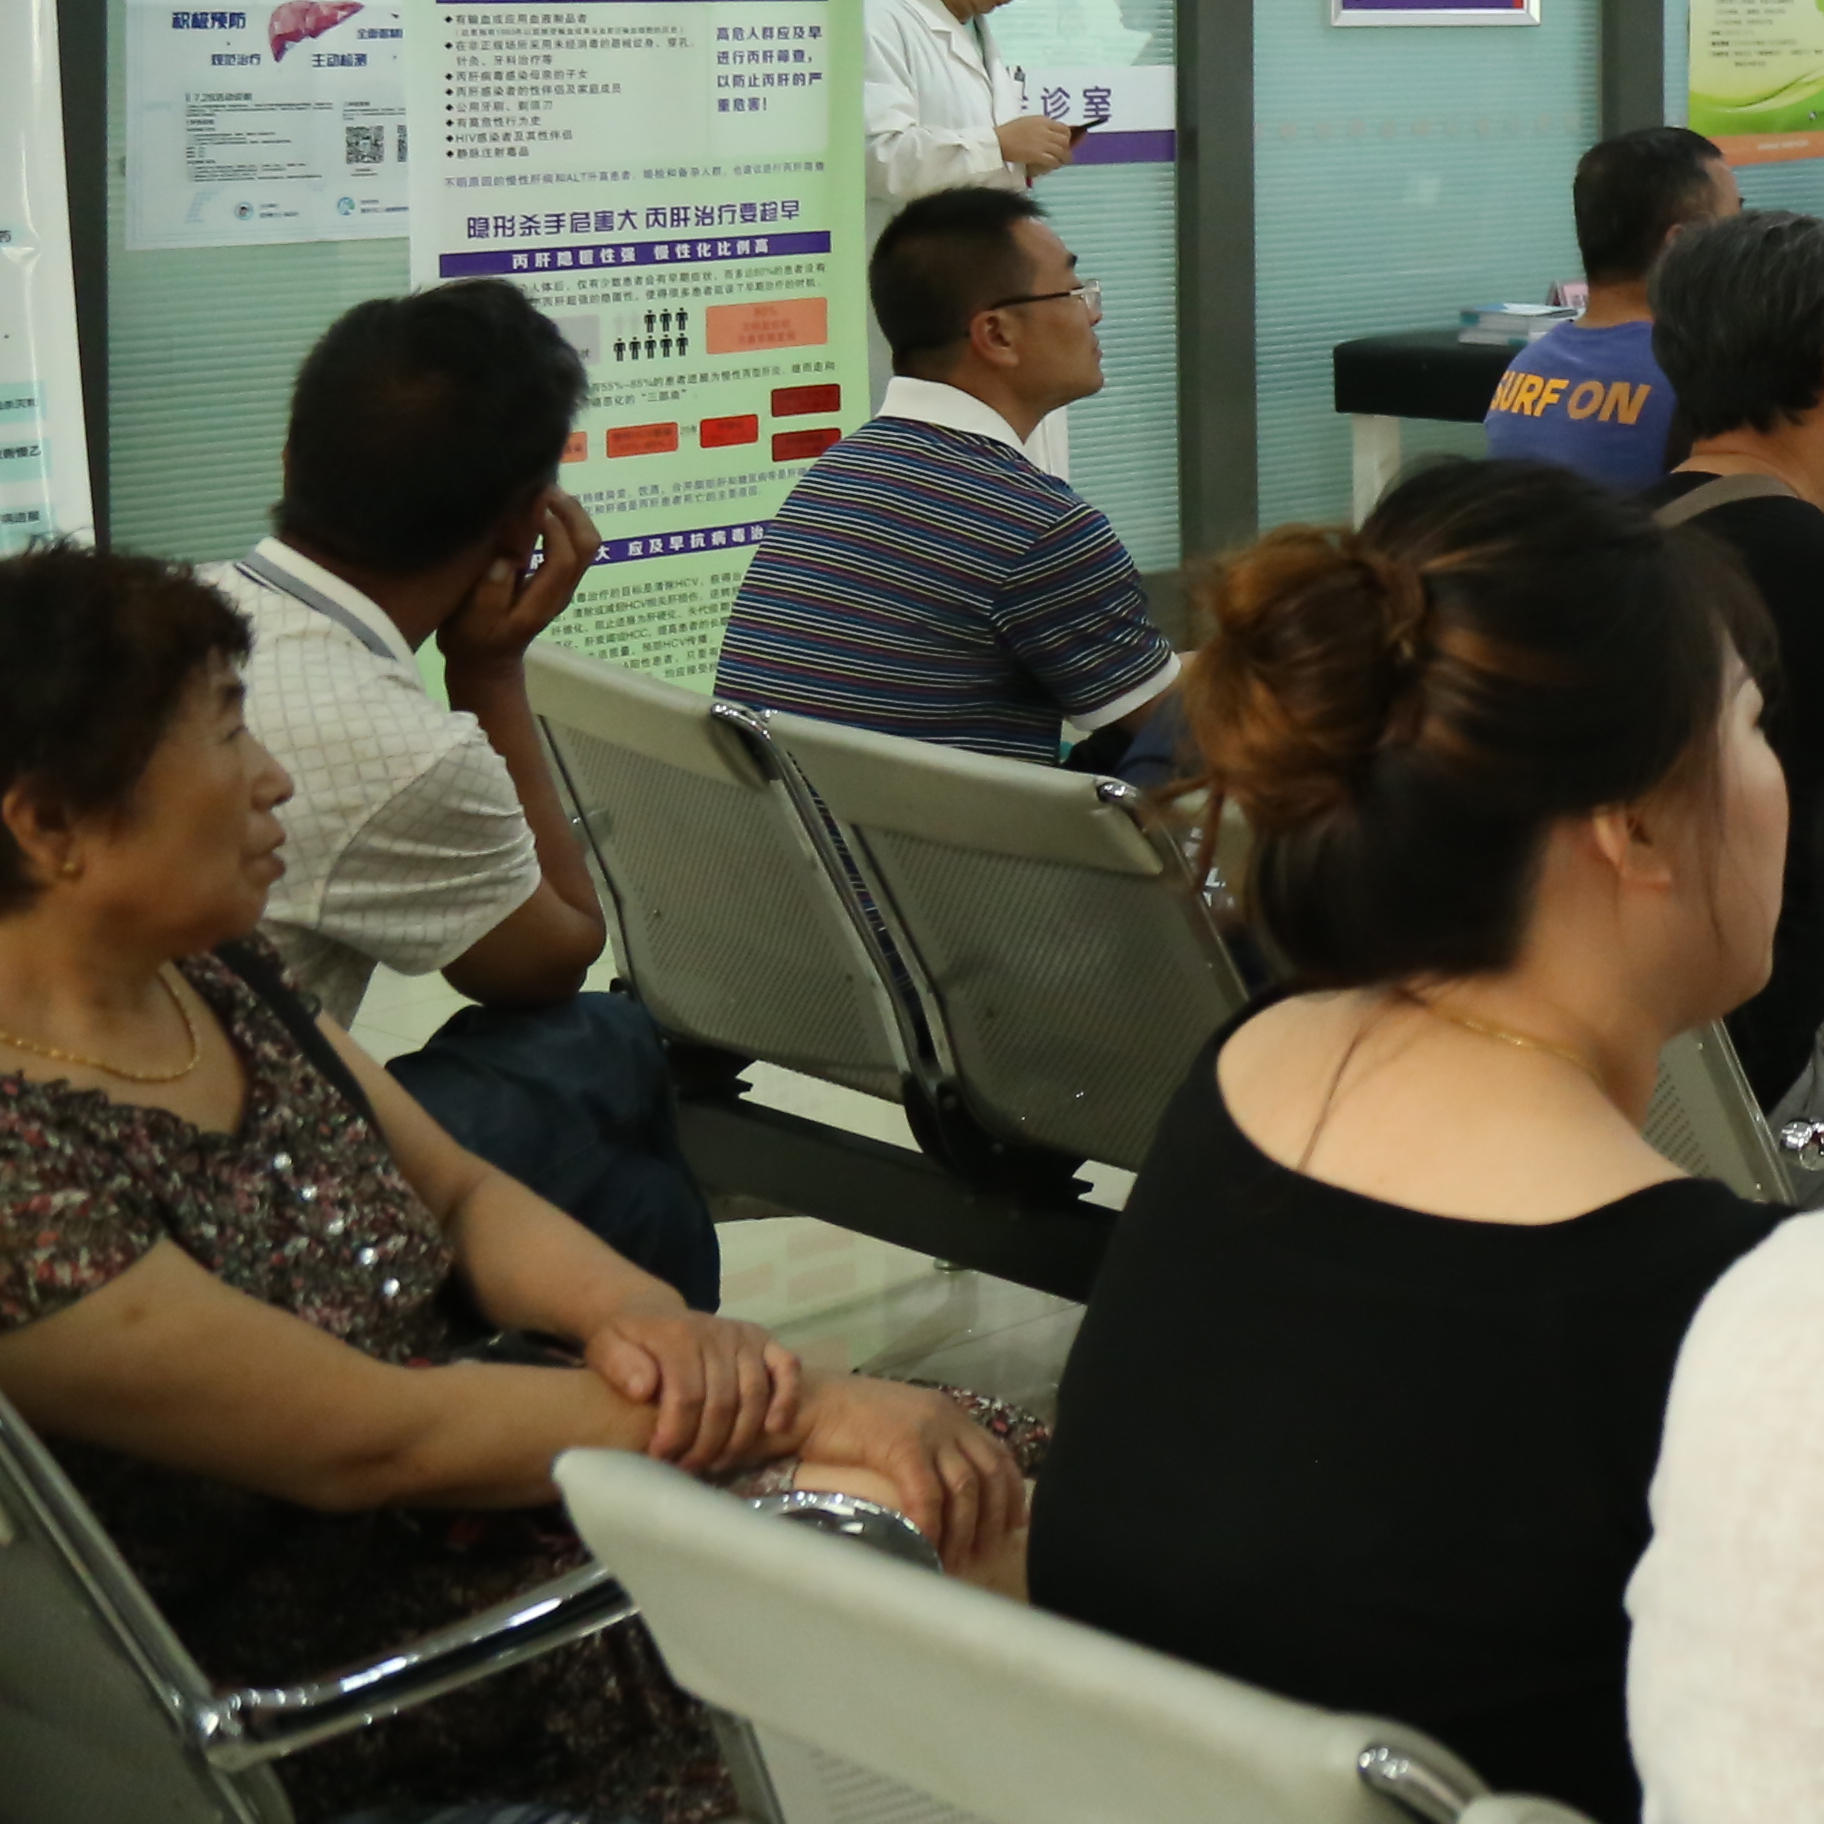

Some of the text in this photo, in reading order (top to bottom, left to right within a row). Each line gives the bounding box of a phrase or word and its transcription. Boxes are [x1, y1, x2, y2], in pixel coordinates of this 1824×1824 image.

[171, 11, 247, 30] 积极预防
[715, 25, 823, 43] 高危人群应及早
[311, 53, 368, 68] 主动检测
[716, 72, 823, 89] 以防止丙肝的严
[1020, 85, 1113, 121] 诊室
[466, 199, 800, 240] 隐形杀手危害大 丙肝治疗要趁早
[653, 238, 770, 262] 慢性化比例高
[1566, 380, 1652, 425] ON
